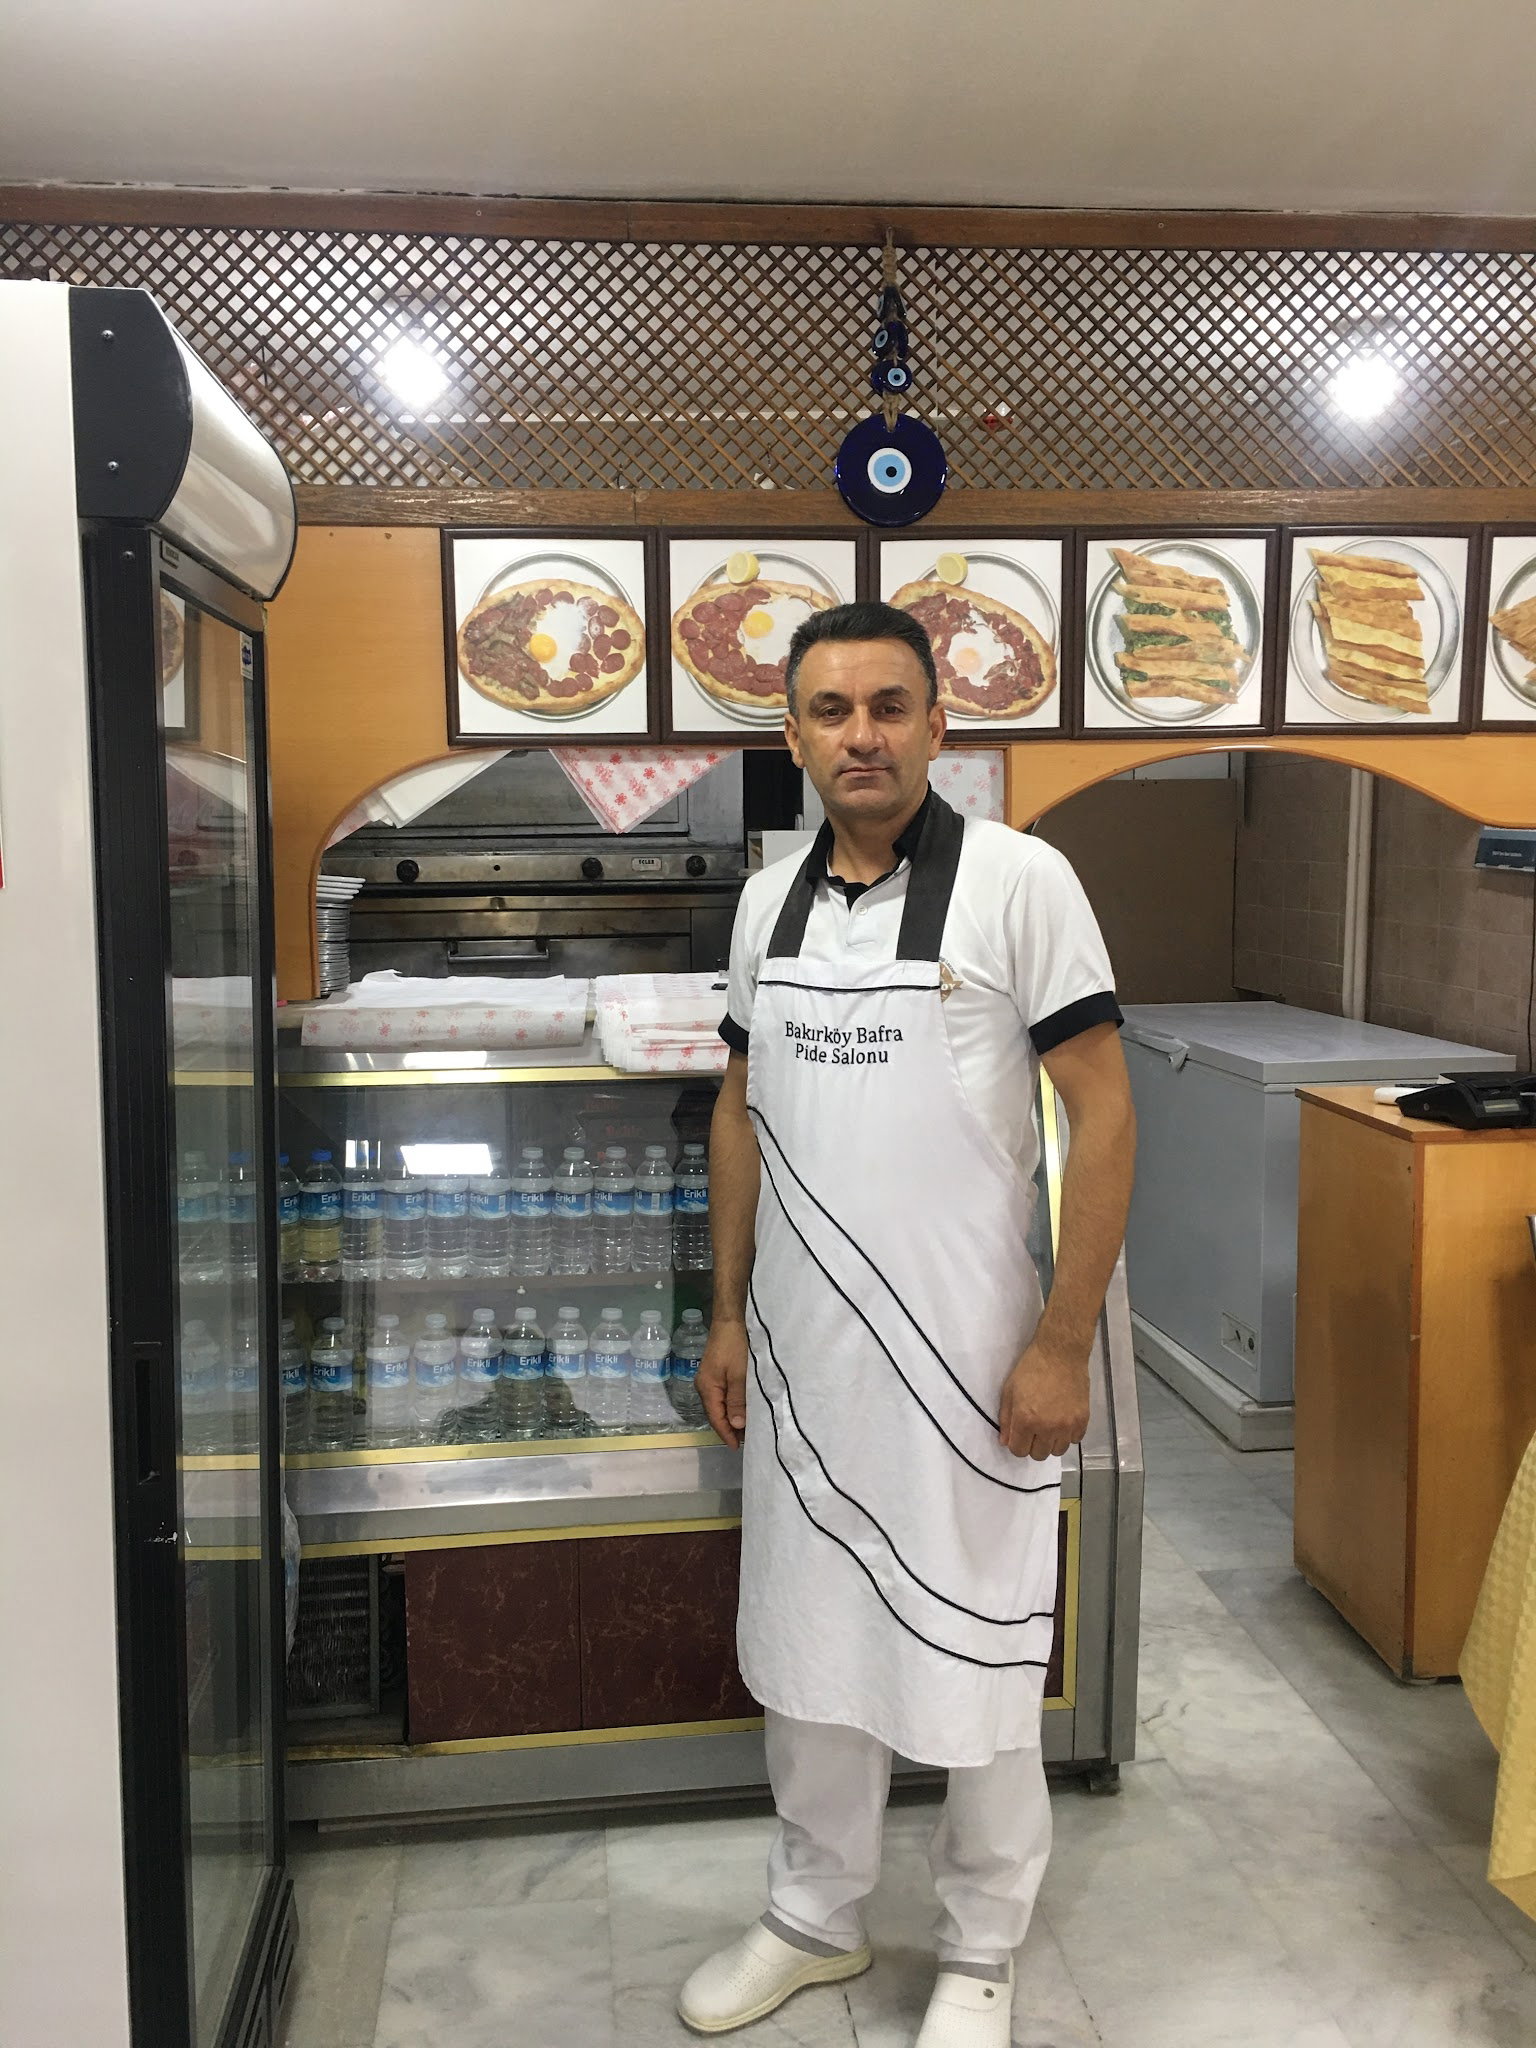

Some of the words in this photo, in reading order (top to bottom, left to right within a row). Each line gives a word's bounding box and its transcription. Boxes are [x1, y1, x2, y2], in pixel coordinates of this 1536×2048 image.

[785, 1021, 852, 1048] Bakırköy
[857, 1025, 903, 1044] Bafra
[795, 1043, 827, 1063] Pide
[831, 1048, 889, 1065] Salonu
[351, 1192, 376, 1202] Erikli
[521, 1192, 544, 1203] Erikli
[555, 1192, 577, 1204] Erikli
[684, 1188, 707, 1199] Erikli
[467, 1358, 491, 1368] Erikli
[548, 1353, 570, 1364] Erikli
[595, 1353, 618, 1364] Erikli
[635, 1358, 658, 1369] Erikli
[313, 1366, 336, 1377] Erikli
